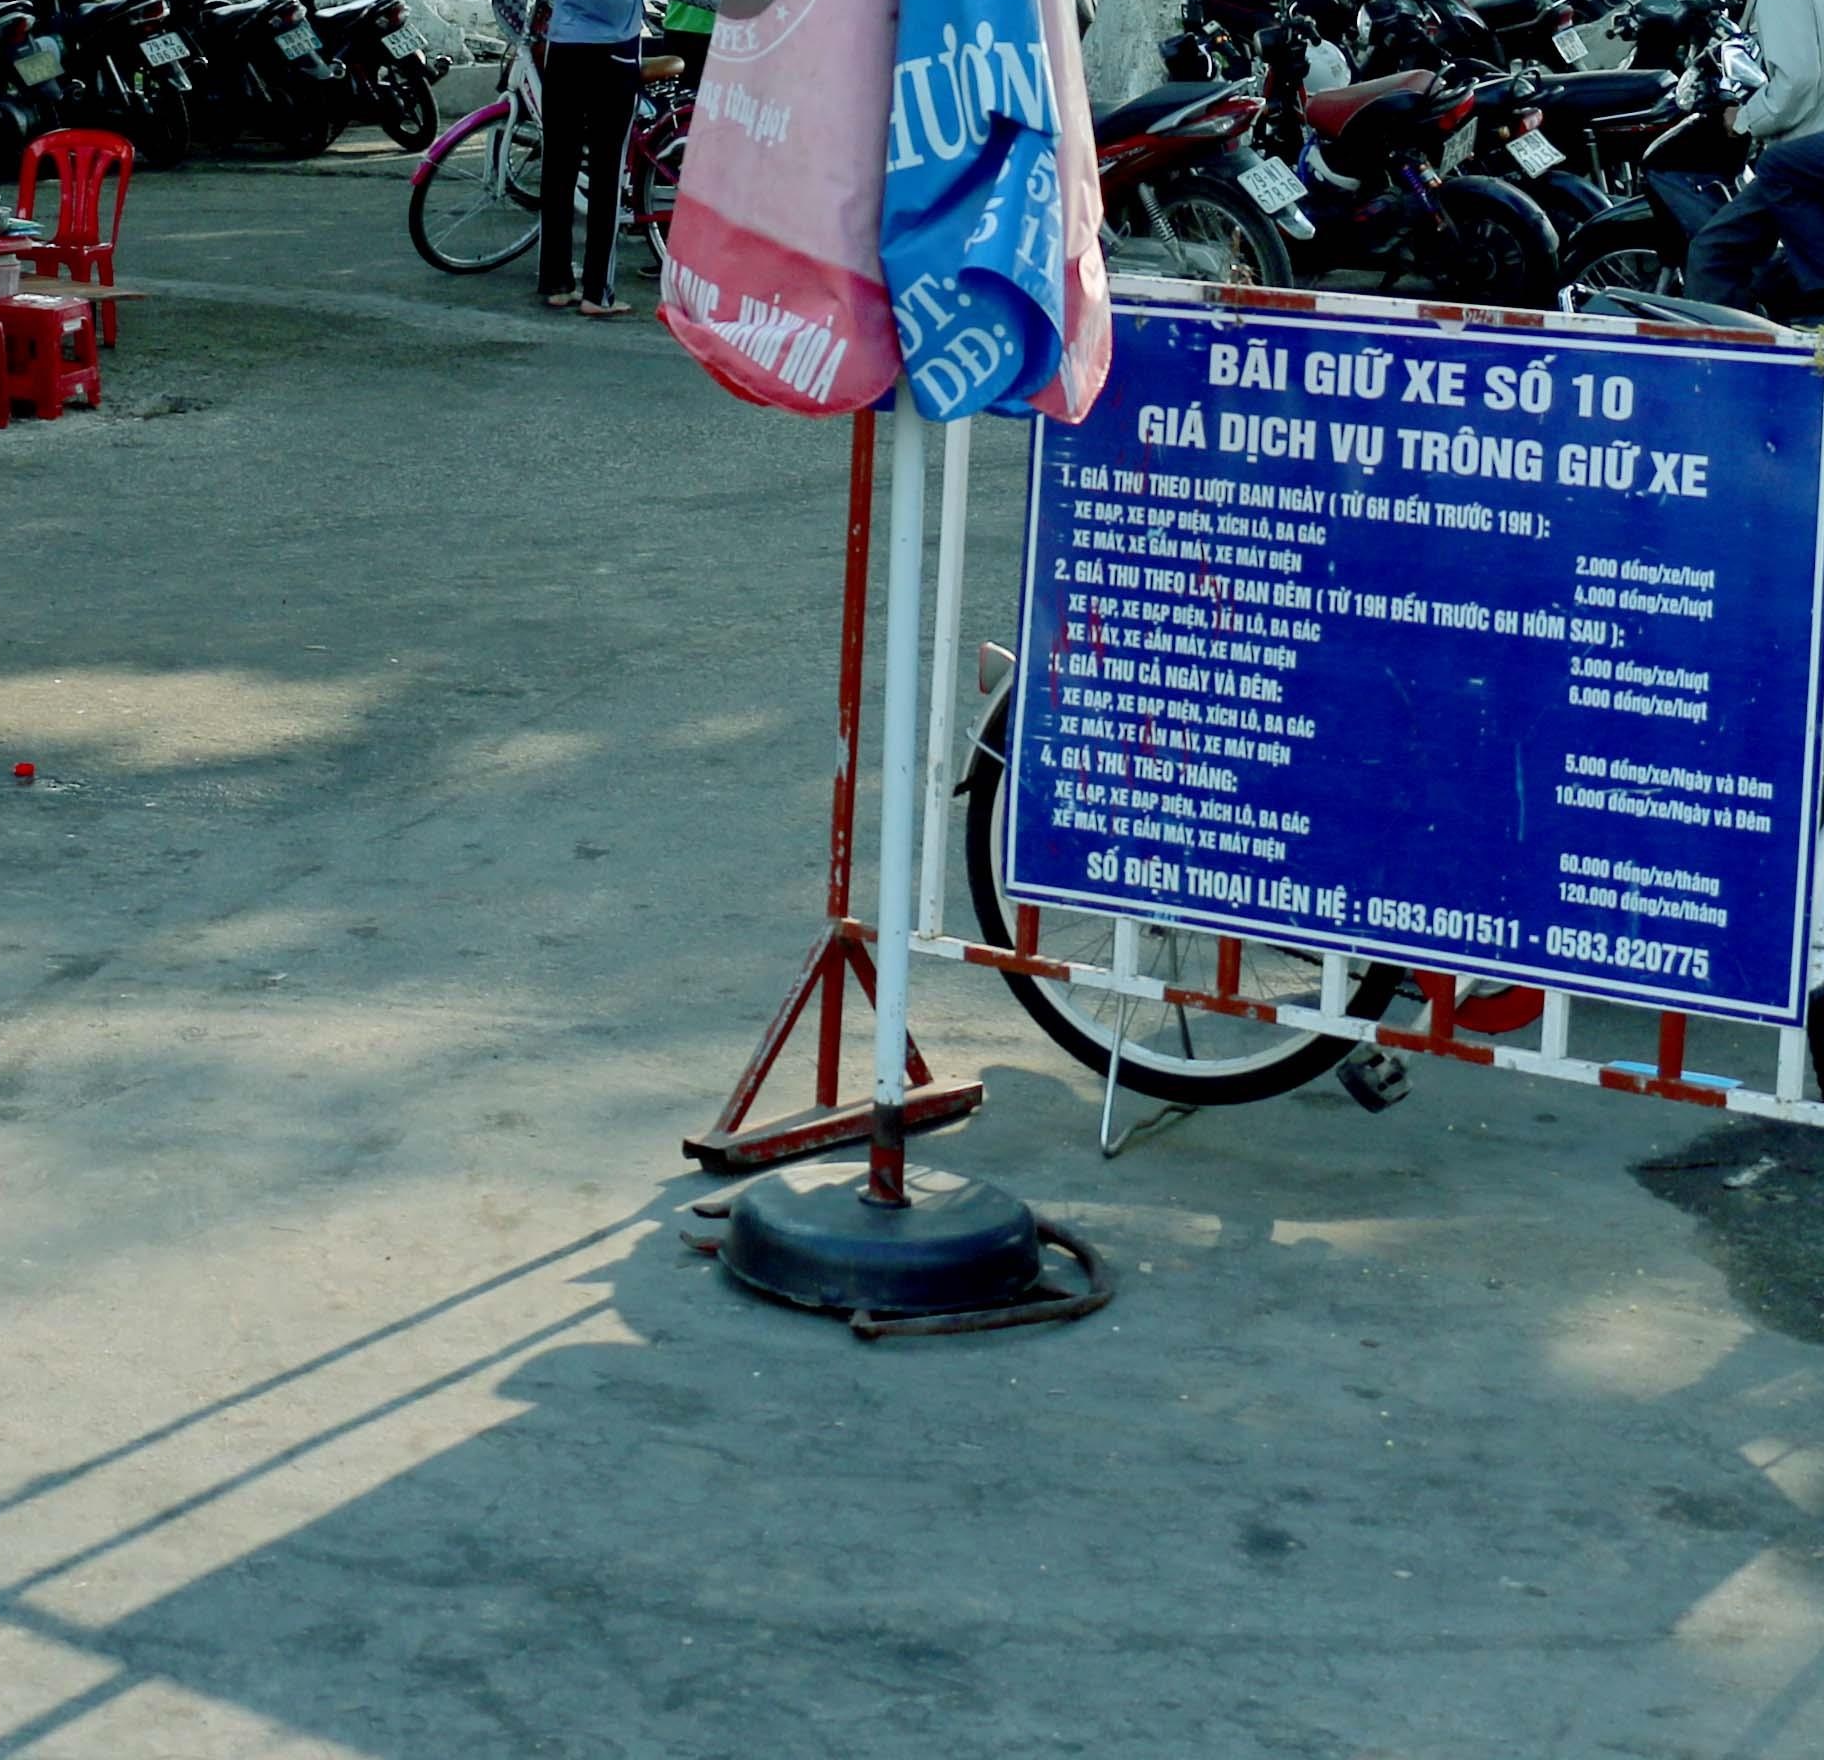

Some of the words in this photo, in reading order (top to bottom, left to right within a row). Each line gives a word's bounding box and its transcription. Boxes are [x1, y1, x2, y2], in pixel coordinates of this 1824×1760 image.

[911, 324, 1015, 418] DĐ:
[1208, 338, 1289, 391] BÃI
[1303, 346, 1394, 399] GIỮ
[1400, 358, 1467, 407] XE
[1482, 353, 1556, 414] SỐ
[1571, 373, 1634, 421] 10
[1137, 400, 1206, 449] GIÁ
[1218, 411, 1317, 463] DỊCH
[1328, 421, 1384, 475] VỤ
[1396, 424, 1543, 482] TRÔNG
[1557, 439, 1642, 492] GIỮ
[1647, 450, 1709, 498] XE
[1060, 465, 1076, 488] 1.
[1079, 463, 1109, 491] GIÁ
[1112, 469, 1144, 495] THU
[1147, 472, 1191, 499] THEO
[1193, 477, 1236, 508] LƯỢT
[1238, 482, 1275, 508] BAN
[1277, 484, 1325, 514] NGÀY
[1340, 489, 1365, 518] TỪ
[1365, 495, 1390, 521] 6H
[1392, 493, 1430, 525] ĐẾN
[1434, 501, 1493, 532] TRƯỚC
[1497, 509, 1532, 536] 19H
[1073, 499, 1092, 520] XE
[1126, 505, 1145, 525] XE
[1216, 512, 1249, 537] XÍCH
[1296, 521, 1326, 545] GÁC
[1071, 528, 1091, 548] XE
[1092, 529, 1125, 553] MÁY,
[1127, 533, 1146, 554] XE
[1179, 538, 1212, 563] MÁY,
[1214, 544, 1233, 564] XE
[1235, 545, 1267, 568] MÁY
[1268, 548, 1302, 575] ĐIỆN
[1574, 555, 1618, 579] 2.000
[1053, 557, 1070, 581] 2.
[1074, 557, 1104, 585] GIÁ
[1107, 562, 1140, 589] THU
[1142, 566, 1186, 595] THEO
[1232, 577, 1270, 604] BAN
[1272, 579, 1312, 610] ĐÊM
[1326, 585, 1352, 614] TỪ
[1353, 592, 1387, 619] 19H
[1389, 591, 1427, 624] ĐẾN
[1431, 601, 1490, 631] TRƯỚC
[1493, 608, 1518, 635] 6H
[1521, 608, 1565, 640] HÔM
[1569, 617, 1606, 645] SAU
[1573, 584, 1616, 608] 4.000
[1067, 650, 1098, 678] GIÁ
[1101, 656, 1135, 682] THU
[1137, 655, 1161, 686] CẢ
[1164, 663, 1210, 692] NGÀY
[1213, 668, 1235, 697] VÀ
[1238, 672, 1283, 703] ĐÊM:
[1569, 655, 1612, 679] 3.000
[1061, 685, 1081, 706] XE
[1115, 692, 1135, 713] XE
[1204, 702, 1238, 727] XÍCH
[1285, 714, 1315, 739] GÁC
[1568, 684, 1610, 709] 6.000
[1039, 743, 1058, 768] 4.
[1132, 754, 1174, 783] THEO
[1564, 752, 1607, 777] 5.000
[1714, 773, 1734, 794] và
[1736, 774, 1773, 799] Đêm
[1555, 784, 1605, 810] 10.000
[1712, 806, 1732, 828] và
[1734, 808, 1771, 833] Đêm
[1559, 852, 1610, 879] 60.000
[1085, 844, 1119, 882] SỐ
[1123, 854, 1180, 895] ĐIỆN
[1184, 865, 1252, 908] THOẠI
[1256, 875, 1310, 914] LIÊN
[1315, 884, 1347, 926] HỆ
[1366, 896, 1519, 949] 0583.601511
[1545, 924, 1709, 979] 0583.820775
[1558, 881, 1617, 909] 120.000
